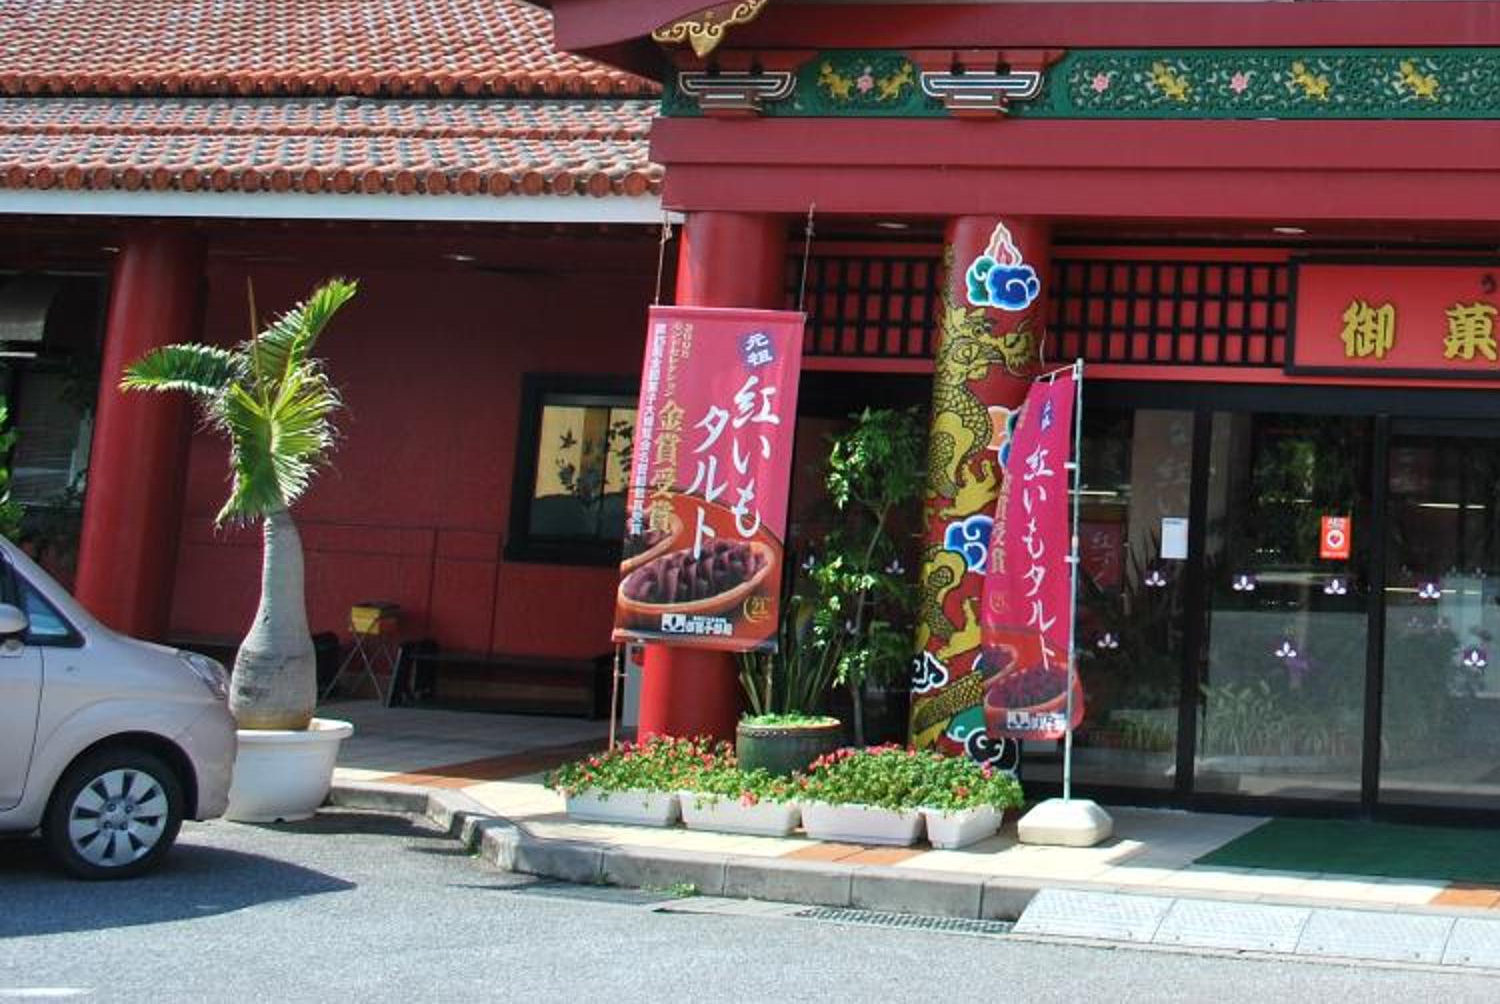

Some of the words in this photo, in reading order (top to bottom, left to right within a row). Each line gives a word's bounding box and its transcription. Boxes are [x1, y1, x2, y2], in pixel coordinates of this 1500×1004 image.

[745, 333, 773, 366] 元祖
[685, 405, 729, 560] タルト
[731, 376, 780, 538] 紅いも
[1023, 444, 1056, 671] 紅いもタルト
